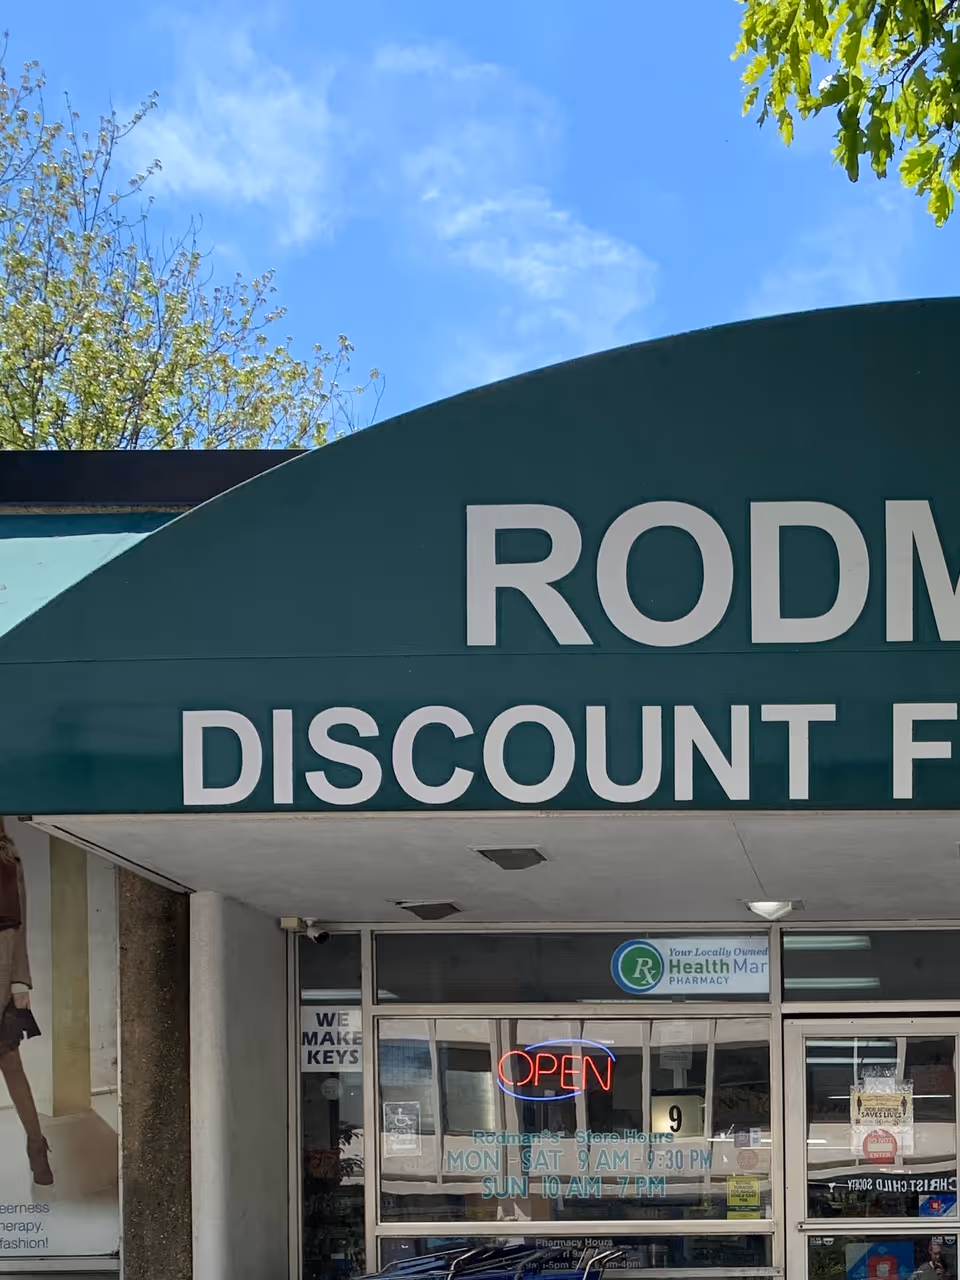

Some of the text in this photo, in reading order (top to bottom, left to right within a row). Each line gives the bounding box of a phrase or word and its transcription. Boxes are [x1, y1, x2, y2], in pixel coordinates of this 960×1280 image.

[182, 703, 836, 806] DISCOUNT
[669, 947, 768, 958] Your Locally Owned
[669, 959, 730, 975] Health
[669, 976, 730, 985] PHARMACY
[316, 1012, 349, 1028] WE
[302, 1031, 362, 1046] MAKE
[307, 1050, 359, 1065] KEYS
[498, 1050, 612, 1091] OPEN
[669, 1104, 682, 1133] 9
[575, 1131, 620, 1145] Store
[625, 1129, 675, 1144] Hours
[446, 1149, 500, 1172] MON
[521, 1149, 562, 1172] SAT
[577, 1149, 589, 1171] 9
[595, 1149, 631, 1171] AM
[646, 1149, 684, 1170] 9:30
[689, 1149, 713, 1170] PM
[481, 1176, 528, 1199] SUN
[542, 1176, 560, 1198] 10
[565, 1176, 601, 1198] AM
[618, 1176, 630, 1198] 7
[635, 1176, 666, 1198] PM
[0, 1203, 50, 1214] eerness
[0, 1237, 49, 1249] fashion!
[535, 1237, 614, 1248] Pharmacy Hours
